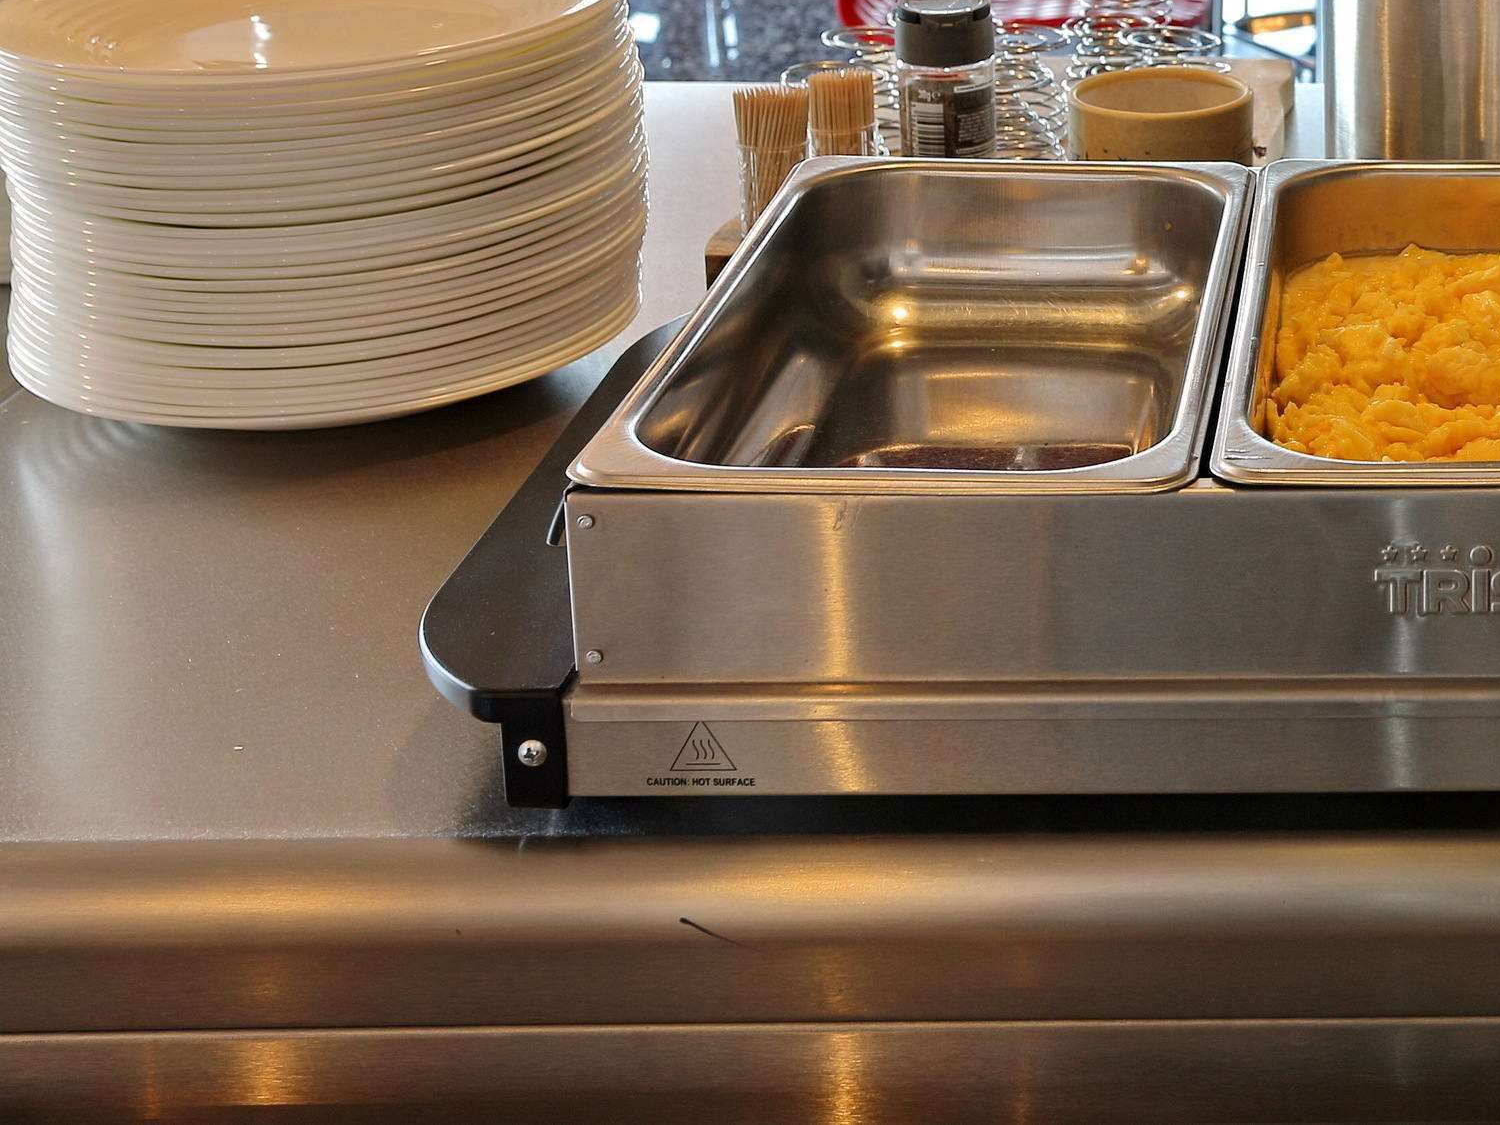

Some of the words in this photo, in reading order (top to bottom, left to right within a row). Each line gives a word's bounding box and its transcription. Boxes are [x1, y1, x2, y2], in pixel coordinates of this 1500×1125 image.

[646, 777, 690, 787] CAUTION:
[692, 777, 710, 787] HOT
[712, 777, 756, 787] SURFACE
